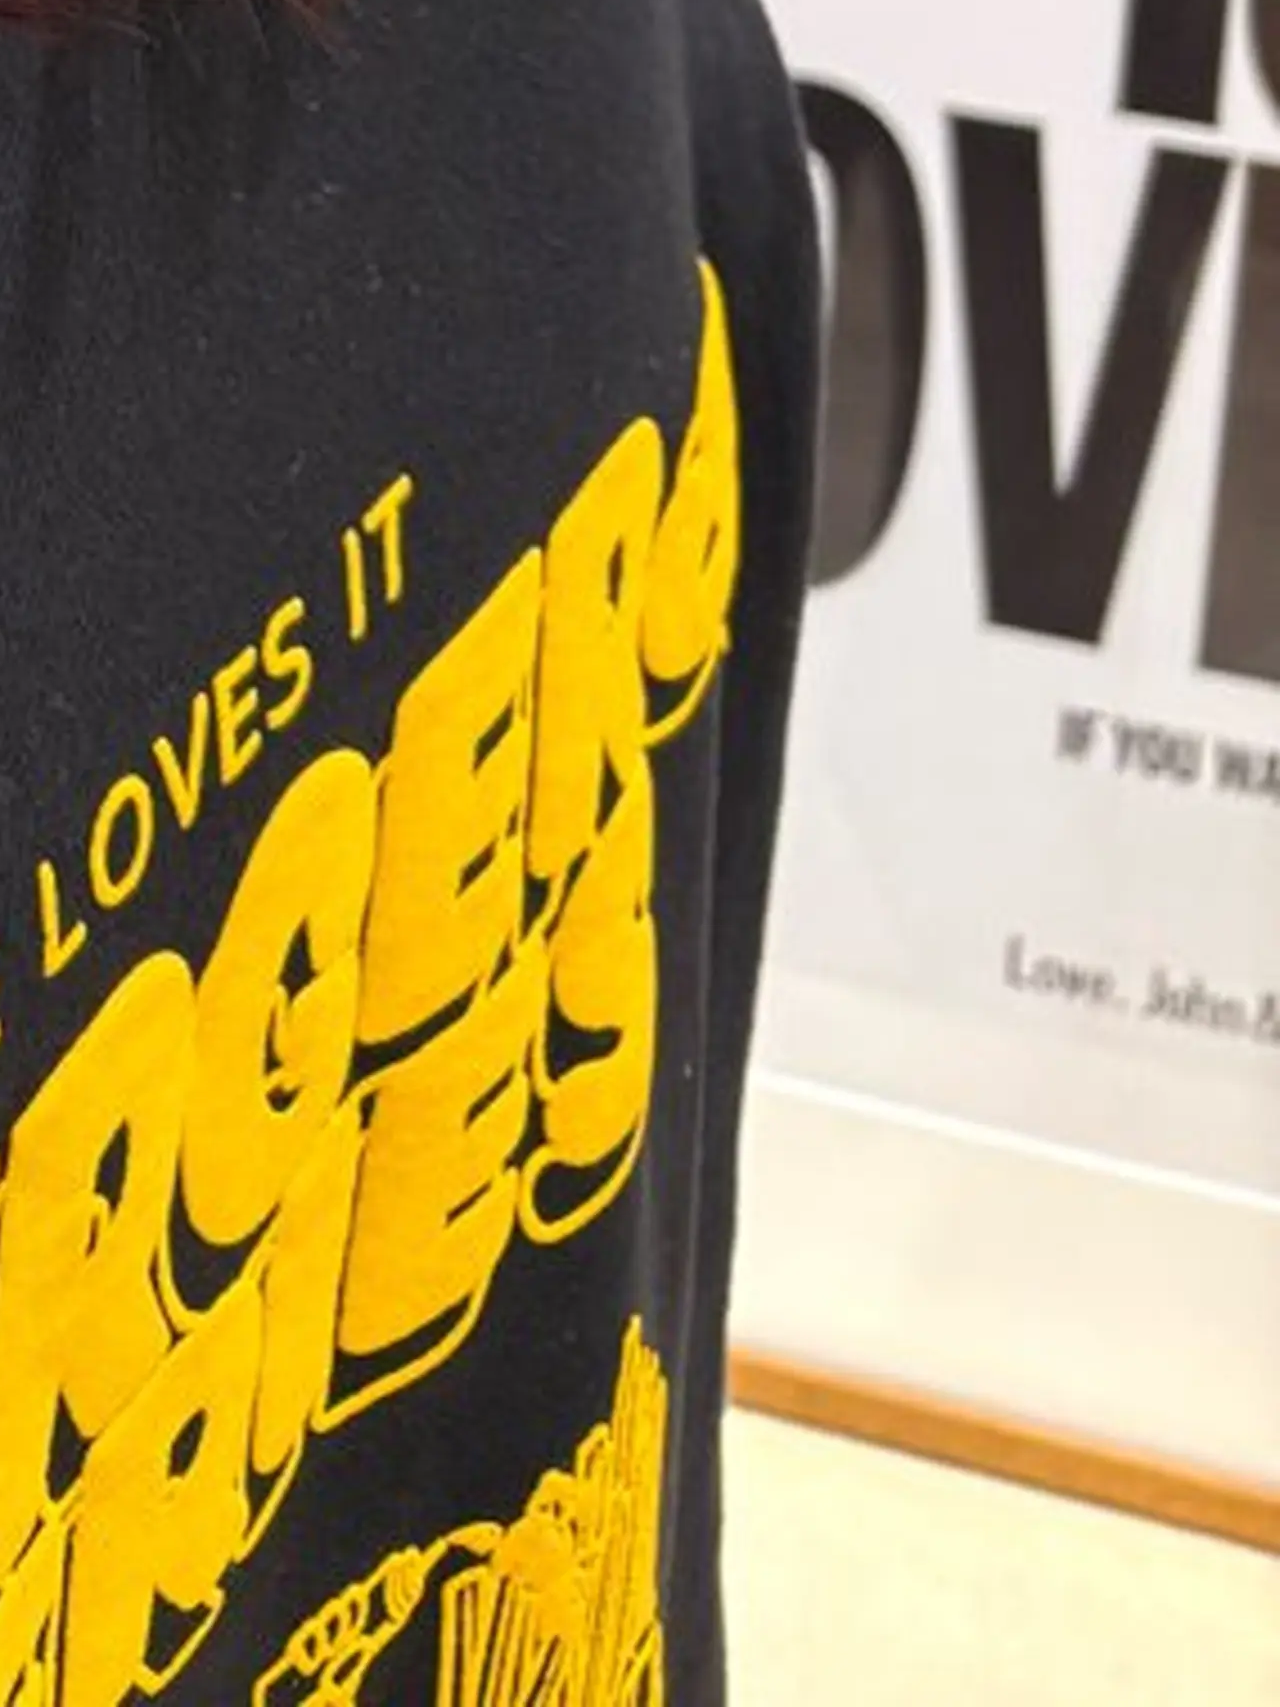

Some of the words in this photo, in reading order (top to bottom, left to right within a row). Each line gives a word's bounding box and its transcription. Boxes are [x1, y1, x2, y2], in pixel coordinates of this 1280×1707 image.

[37, 598, 313, 976] LOVES
[342, 477, 413, 640] IT
[1113, 716, 1204, 785] YOU
